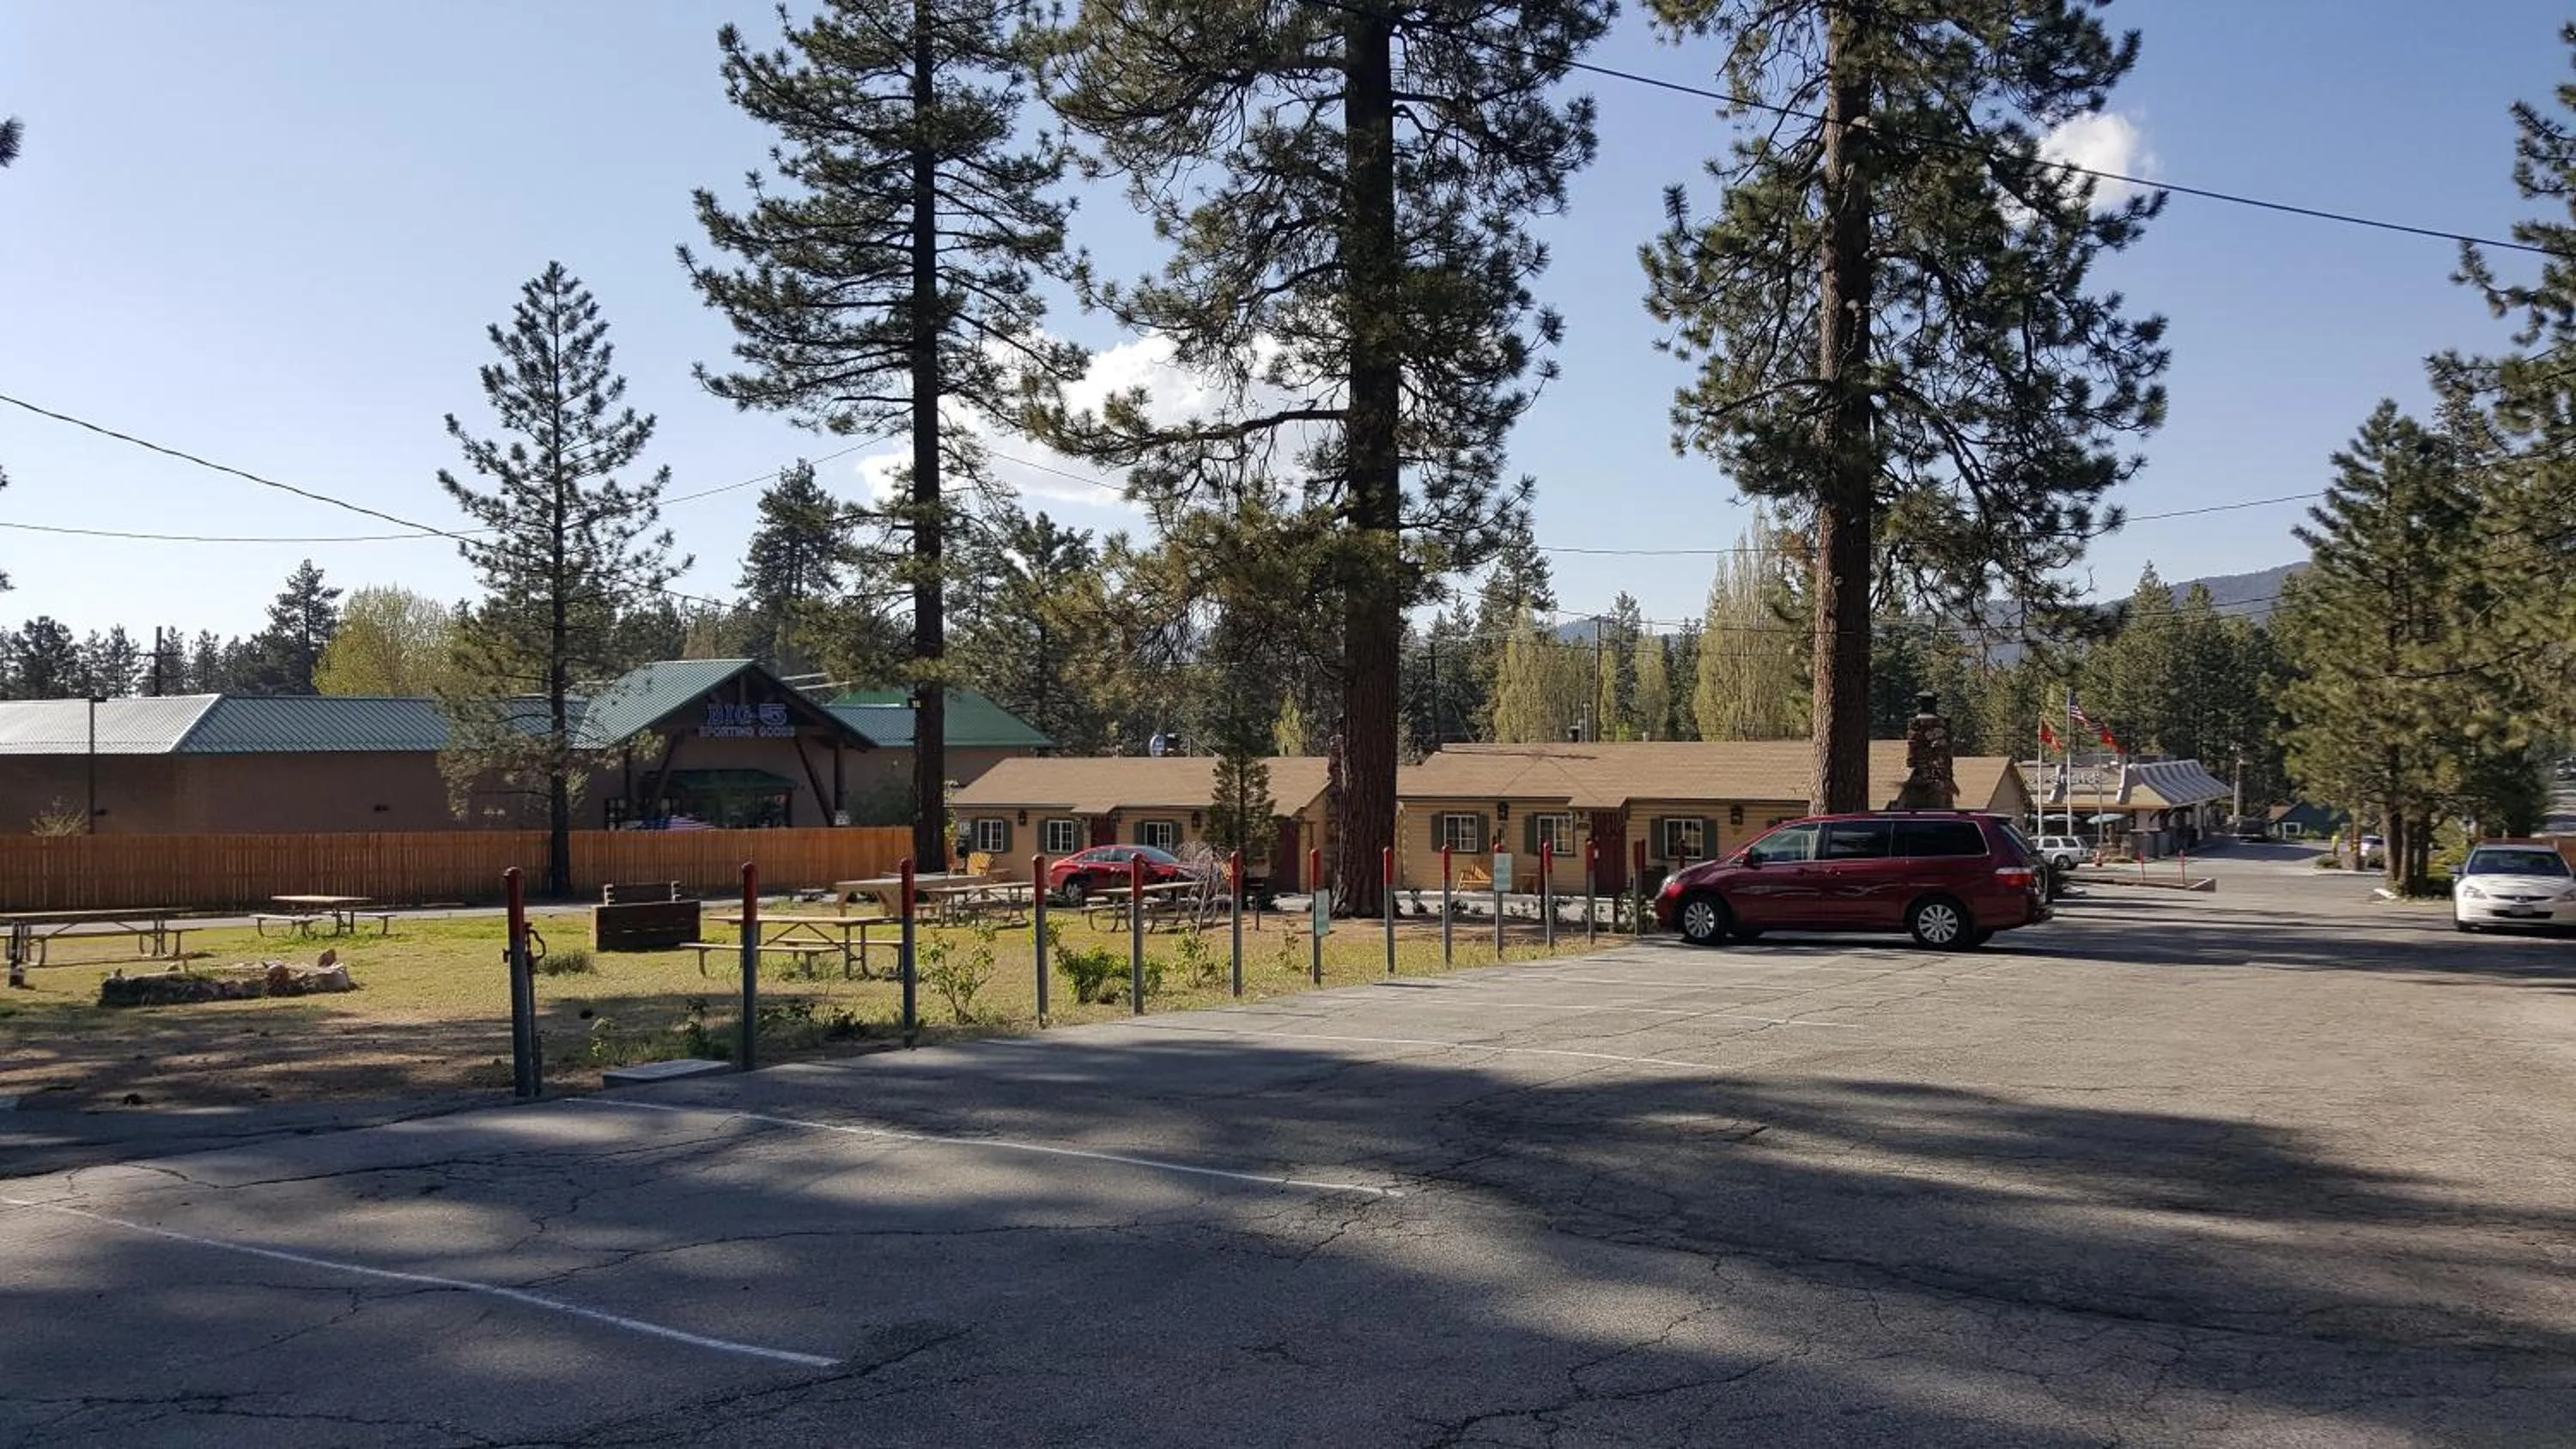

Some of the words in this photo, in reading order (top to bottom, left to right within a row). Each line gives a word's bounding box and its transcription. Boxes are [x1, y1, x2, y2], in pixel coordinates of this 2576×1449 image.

[707, 703, 754, 725] BIG
[758, 703, 787, 726] 5
[699, 725, 755, 737] SPORTING
[758, 725, 795, 737] GOODS
